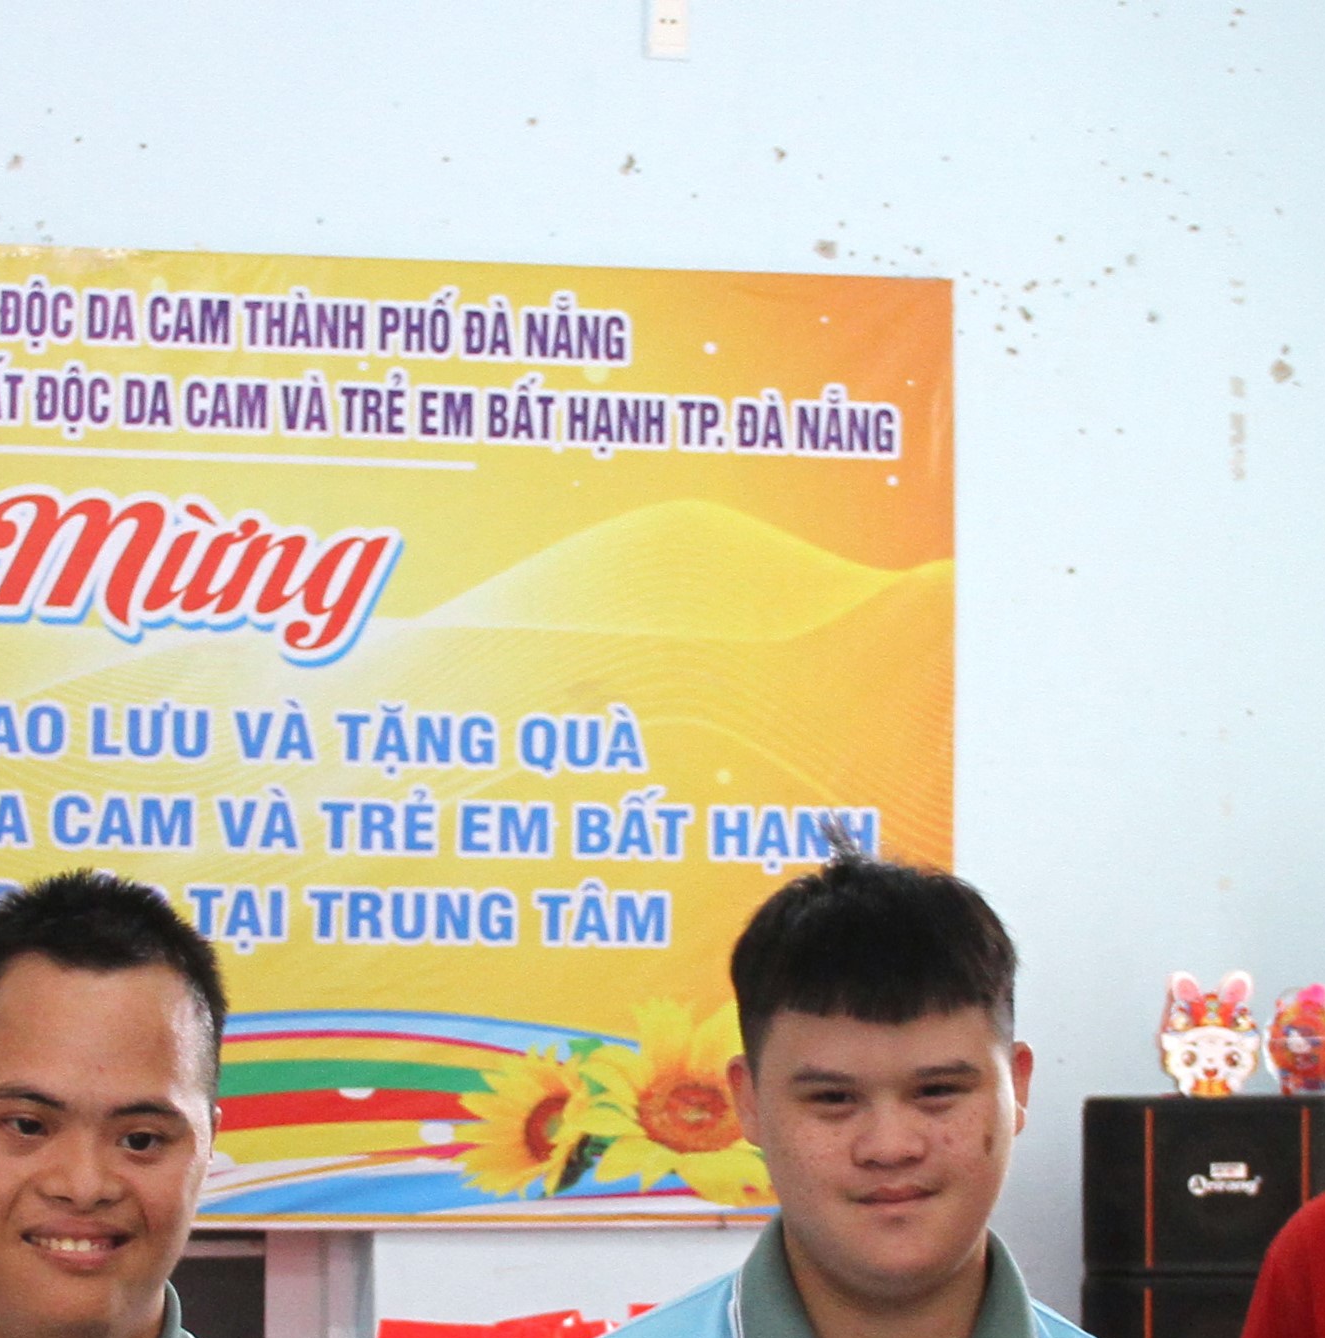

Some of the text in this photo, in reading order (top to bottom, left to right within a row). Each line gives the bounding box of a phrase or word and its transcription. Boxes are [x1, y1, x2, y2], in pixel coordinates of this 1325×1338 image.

[0, 283, 73, 347] ĐỘC
[87, 294, 135, 341] DA
[149, 296, 229, 345] CAM
[245, 292, 365, 350] THÀNH
[379, 291, 450, 353] PHỐ
[465, 301, 511, 356] ĐÀ
[525, 296, 624, 360] NẴNG
[36, 367, 109, 432] ĐỘC
[126, 379, 171, 426] DA
[186, 381, 268, 430] CAM
[282, 375, 327, 431] VÀ
[341, 373, 405, 433] TRẺ
[420, 391, 473, 436] EM
[487, 380, 554, 440] BẤT
[568, 397, 664, 452] HẠNH
[678, 401, 724, 446] TP.
[737, 393, 783, 448] ĐÀ
[798, 388, 893, 452] NẴNG
[92, 703, 209, 759] LƯU
[234, 699, 313, 760] VÀ
[336, 703, 494, 774] TẶNG
[521, 707, 643, 771] QUÀ
[53, 795, 193, 847] CAM
[218, 787, 298, 848] VÀ
[321, 789, 434, 851] TRẺ
[461, 805, 549, 853] EM
[579, 789, 688, 855] BẤT
[714, 811, 873, 868] HẠNH
[188, 889, 282, 948] TẠI
[310, 890, 514, 941] TRUNG
[538, 885, 667, 942] TÂM
